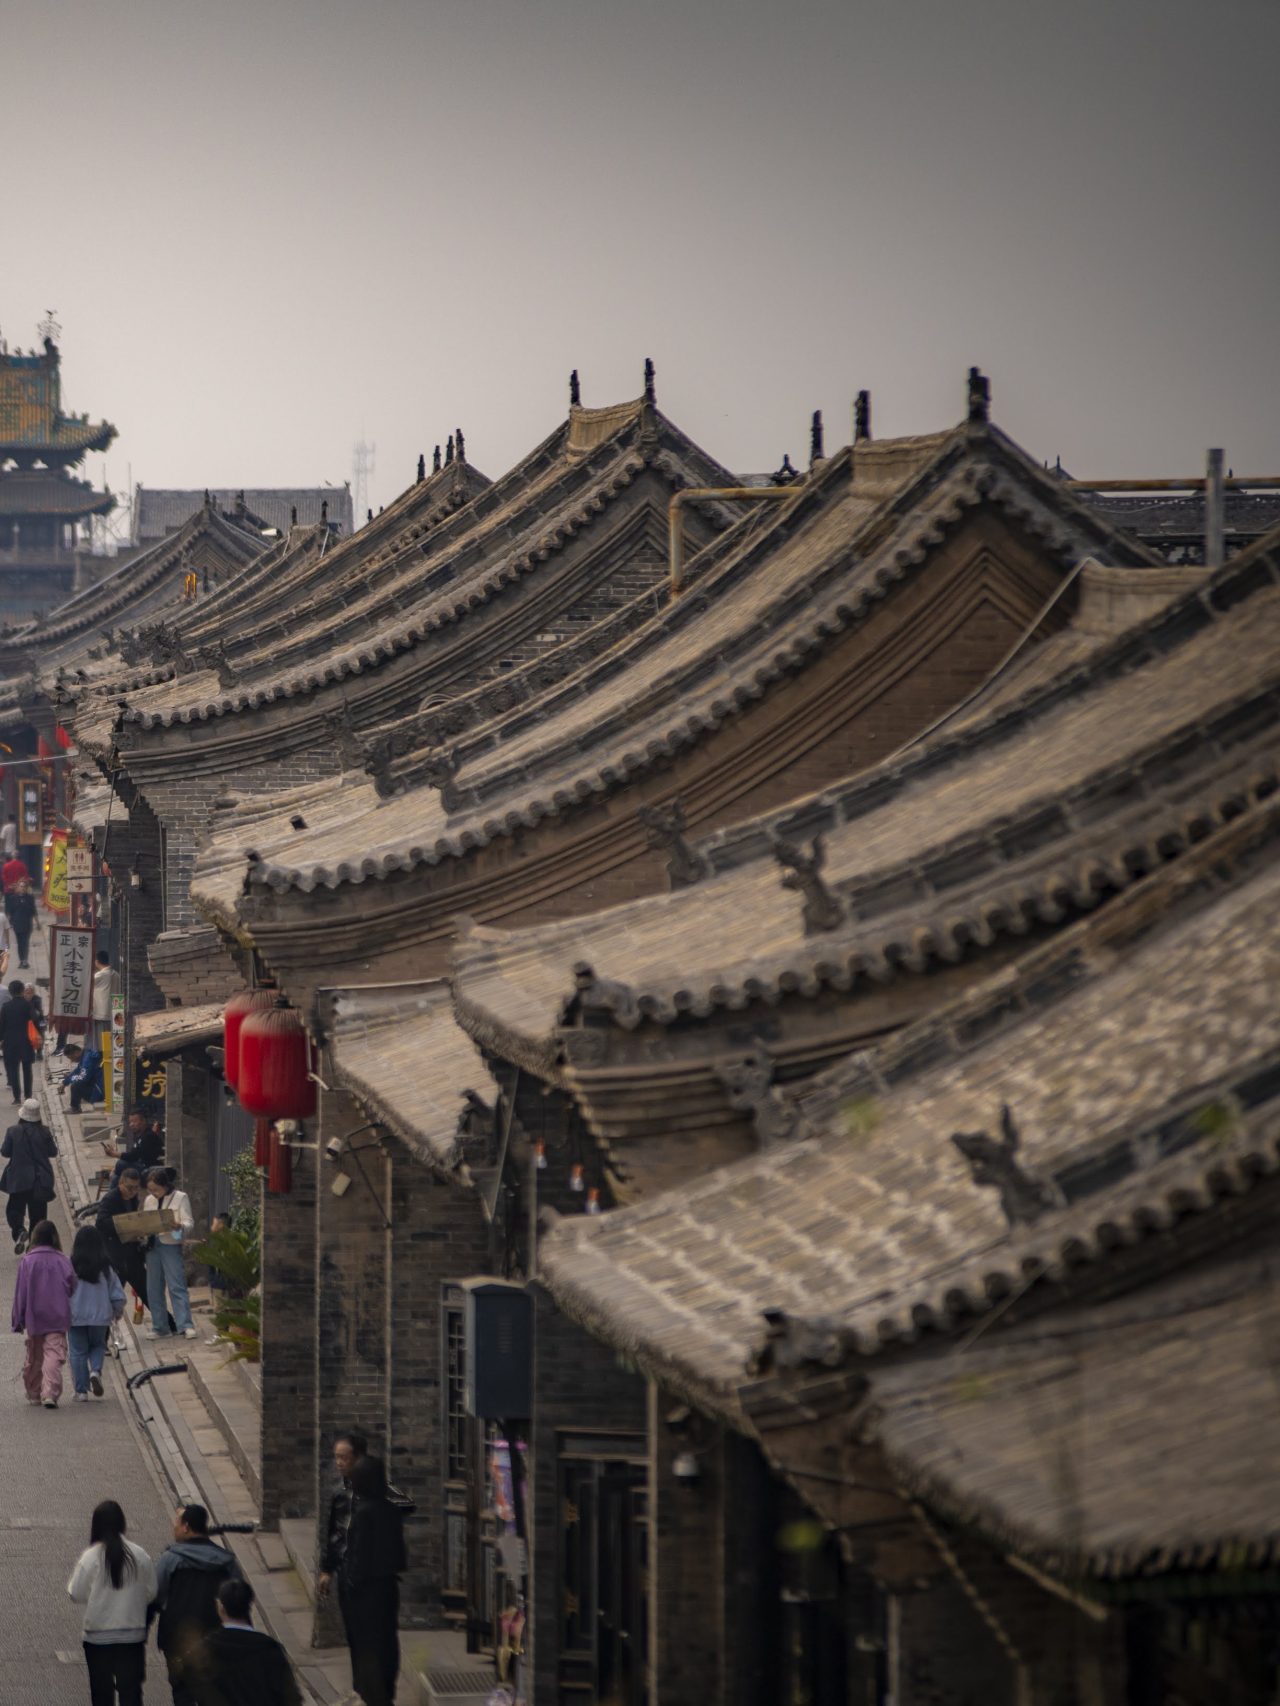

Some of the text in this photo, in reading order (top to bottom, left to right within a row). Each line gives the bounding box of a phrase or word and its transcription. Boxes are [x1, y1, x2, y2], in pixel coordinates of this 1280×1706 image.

[60, 934, 89, 948] 正宗
[61, 947, 84, 1015] 小李飞刀面
